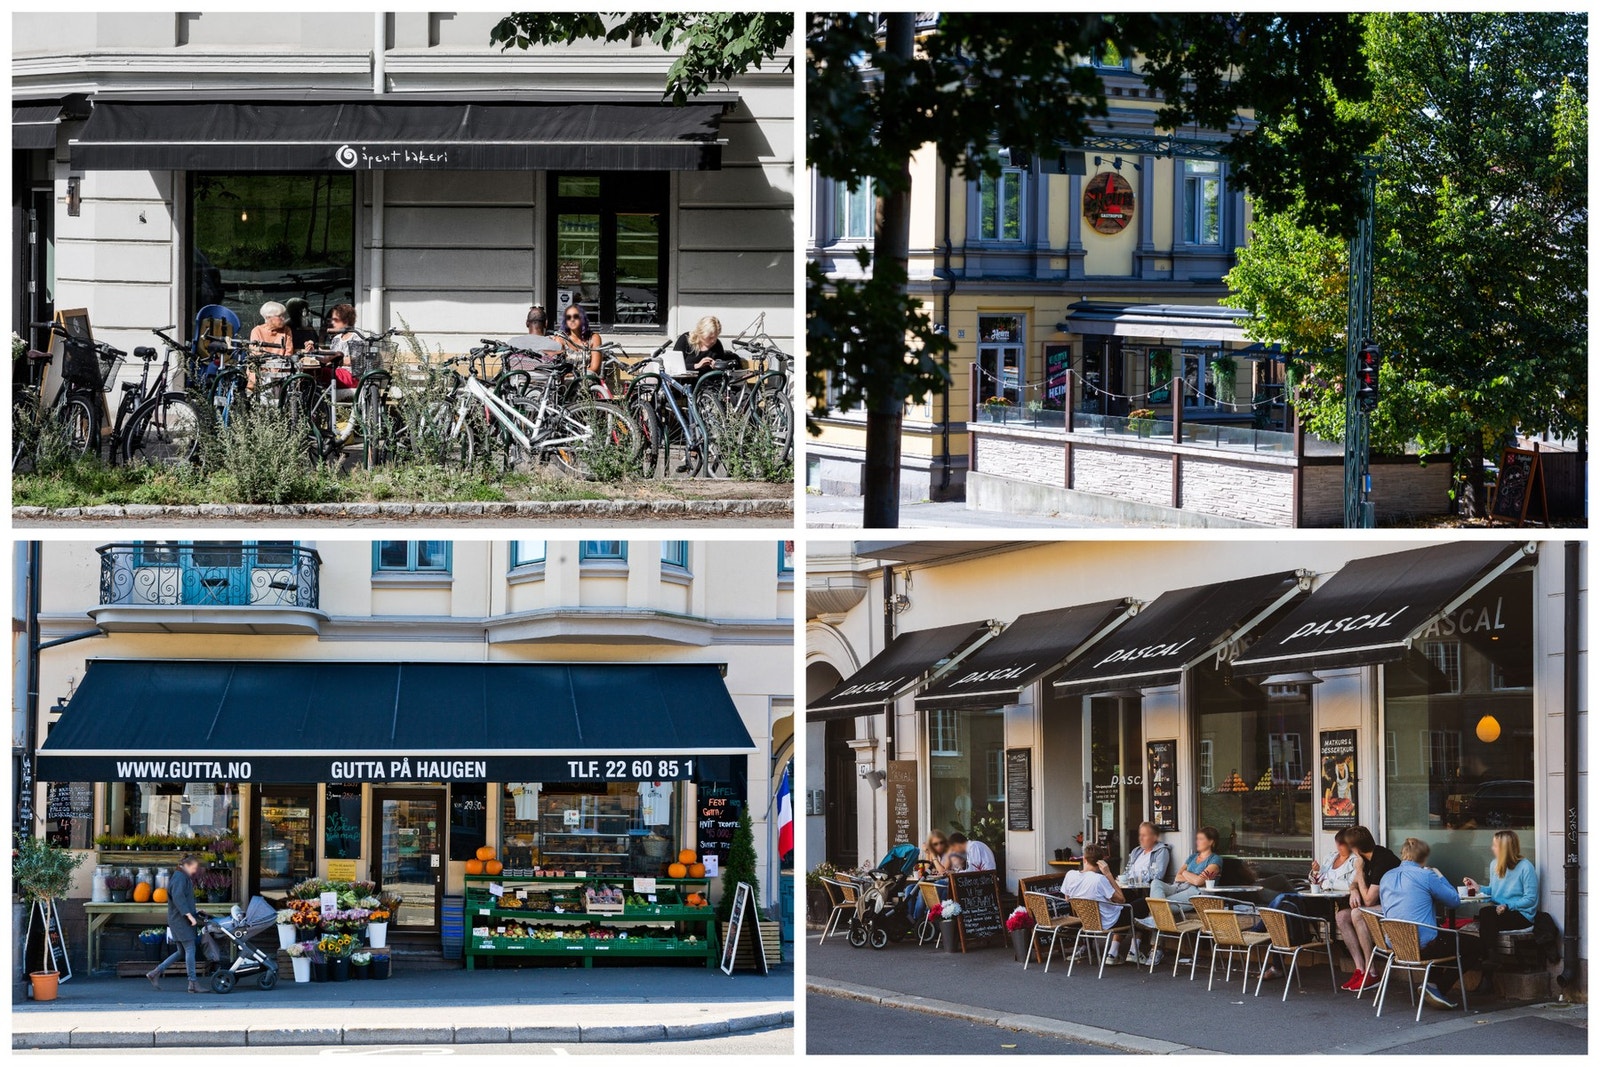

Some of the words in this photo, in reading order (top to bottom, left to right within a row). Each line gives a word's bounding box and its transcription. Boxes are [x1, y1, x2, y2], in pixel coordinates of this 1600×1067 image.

[362, 146, 401, 169] åpent
[405, 150, 448, 164] bakeri
[1279, 605, 1410, 645] PASCAL
[1093, 637, 1196, 669] PASCAL
[948, 663, 1037, 688] PASCAL
[830, 676, 906, 700] PASCAL
[116, 761, 252, 779] WWW.GUTTA.NO
[331, 761, 386, 778] GUTTA
[389, 757, 411, 778] PÅ
[417, 760, 487, 778] HAUGEN
[567, 761, 600, 778] TLF.
[605, 760, 627, 778] 22
[631, 760, 653, 778] 60
[658, 760, 679, 777] 85
[1111, 775, 1143, 788] PASC
[708, 798, 727, 807] FEST
